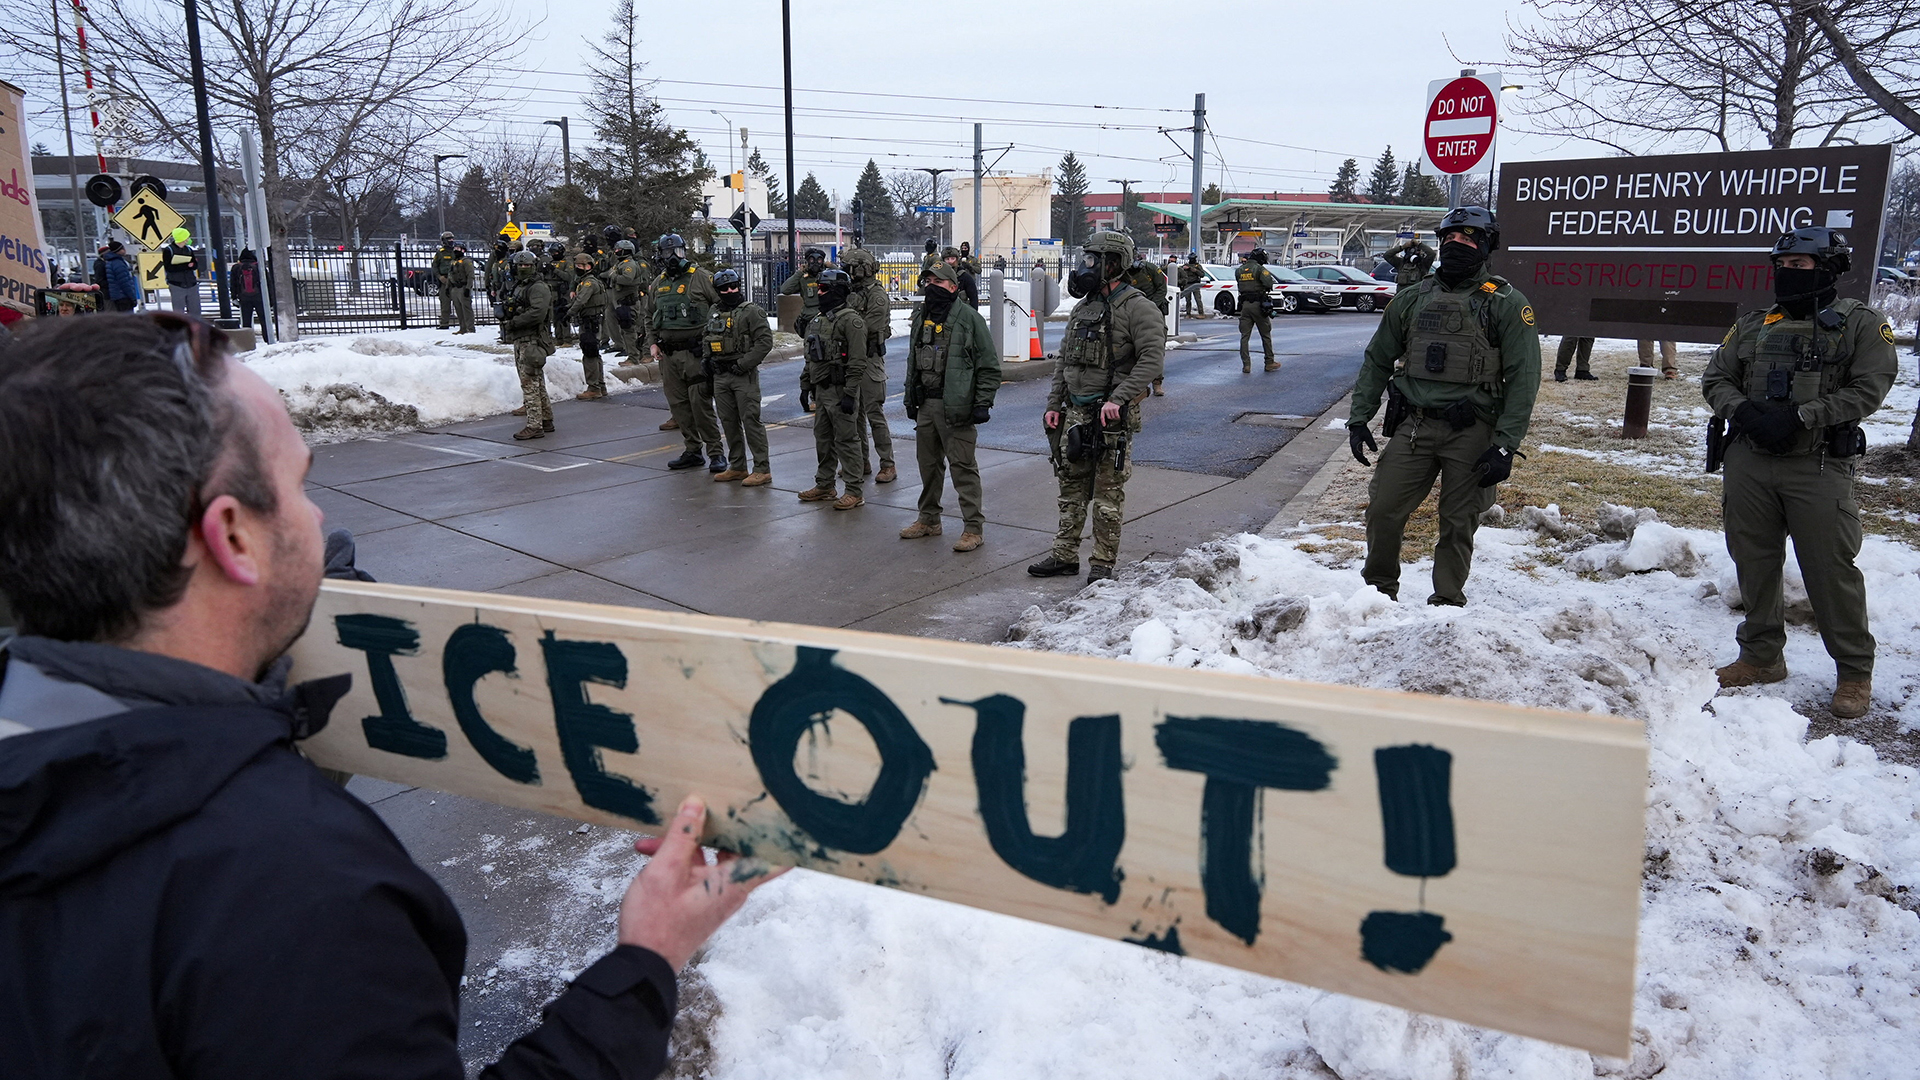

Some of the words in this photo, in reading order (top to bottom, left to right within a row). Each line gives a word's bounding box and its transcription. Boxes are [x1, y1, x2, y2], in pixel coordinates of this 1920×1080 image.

[1438, 98, 1455, 115] DO
[1460, 95, 1486, 113] NOT
[103, 148, 139, 156] TRACKS
[1437, 140, 1477, 157] ENTER
[1516, 175, 1608, 201] BISHOP
[1615, 170, 1712, 199] HENRY
[1719, 165, 1859, 196] WHIPPLE
[1548, 209, 1664, 235] FEDERAL
[1673, 206, 1813, 235] BUILDING
[1534, 262, 1697, 290] RESTRICTED
[1418, 320, 1439, 328] PATROL
[334, 613, 661, 825] ICE
[749, 645, 1455, 974] OUT!
